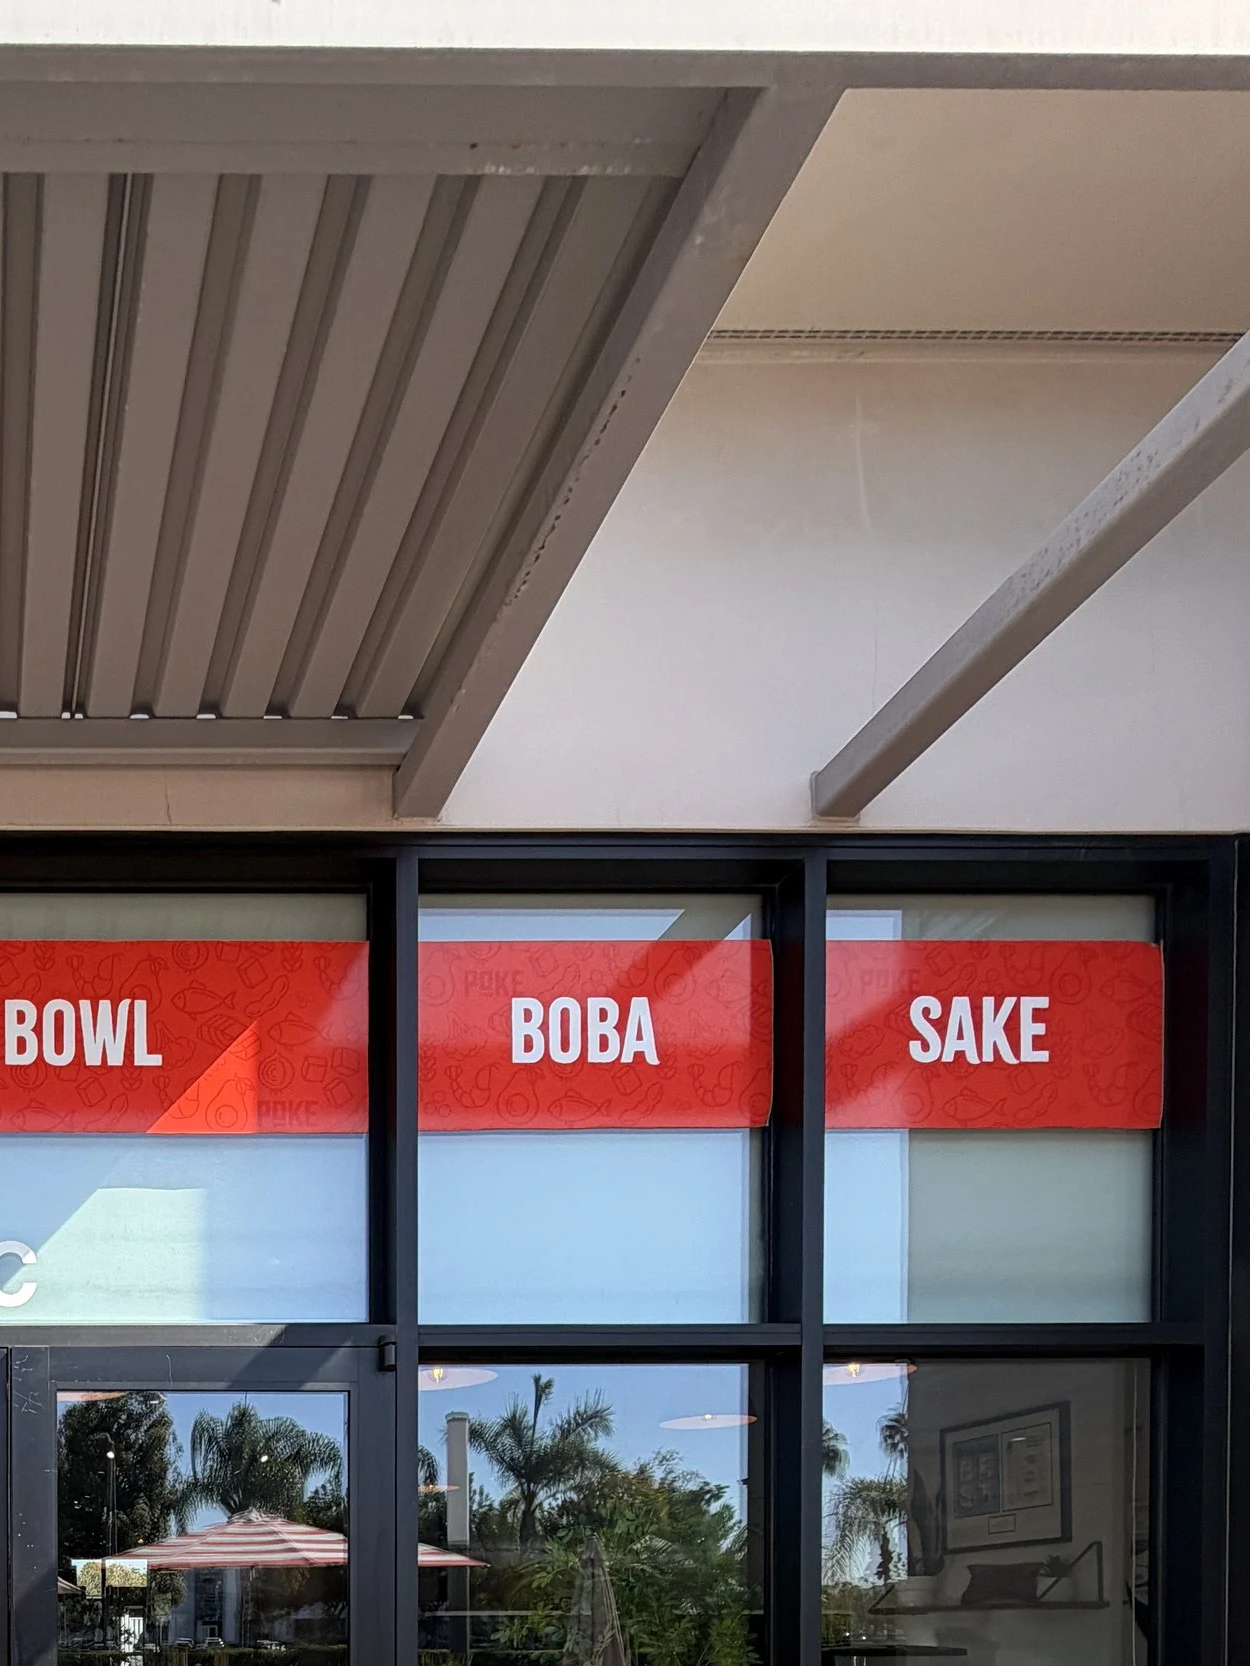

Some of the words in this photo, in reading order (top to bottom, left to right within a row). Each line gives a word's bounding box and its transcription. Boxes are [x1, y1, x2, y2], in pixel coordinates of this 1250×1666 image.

[4, 998, 163, 1067] BOWL
[510, 996, 660, 1066] BOBA
[908, 995, 1050, 1066] SAKE
